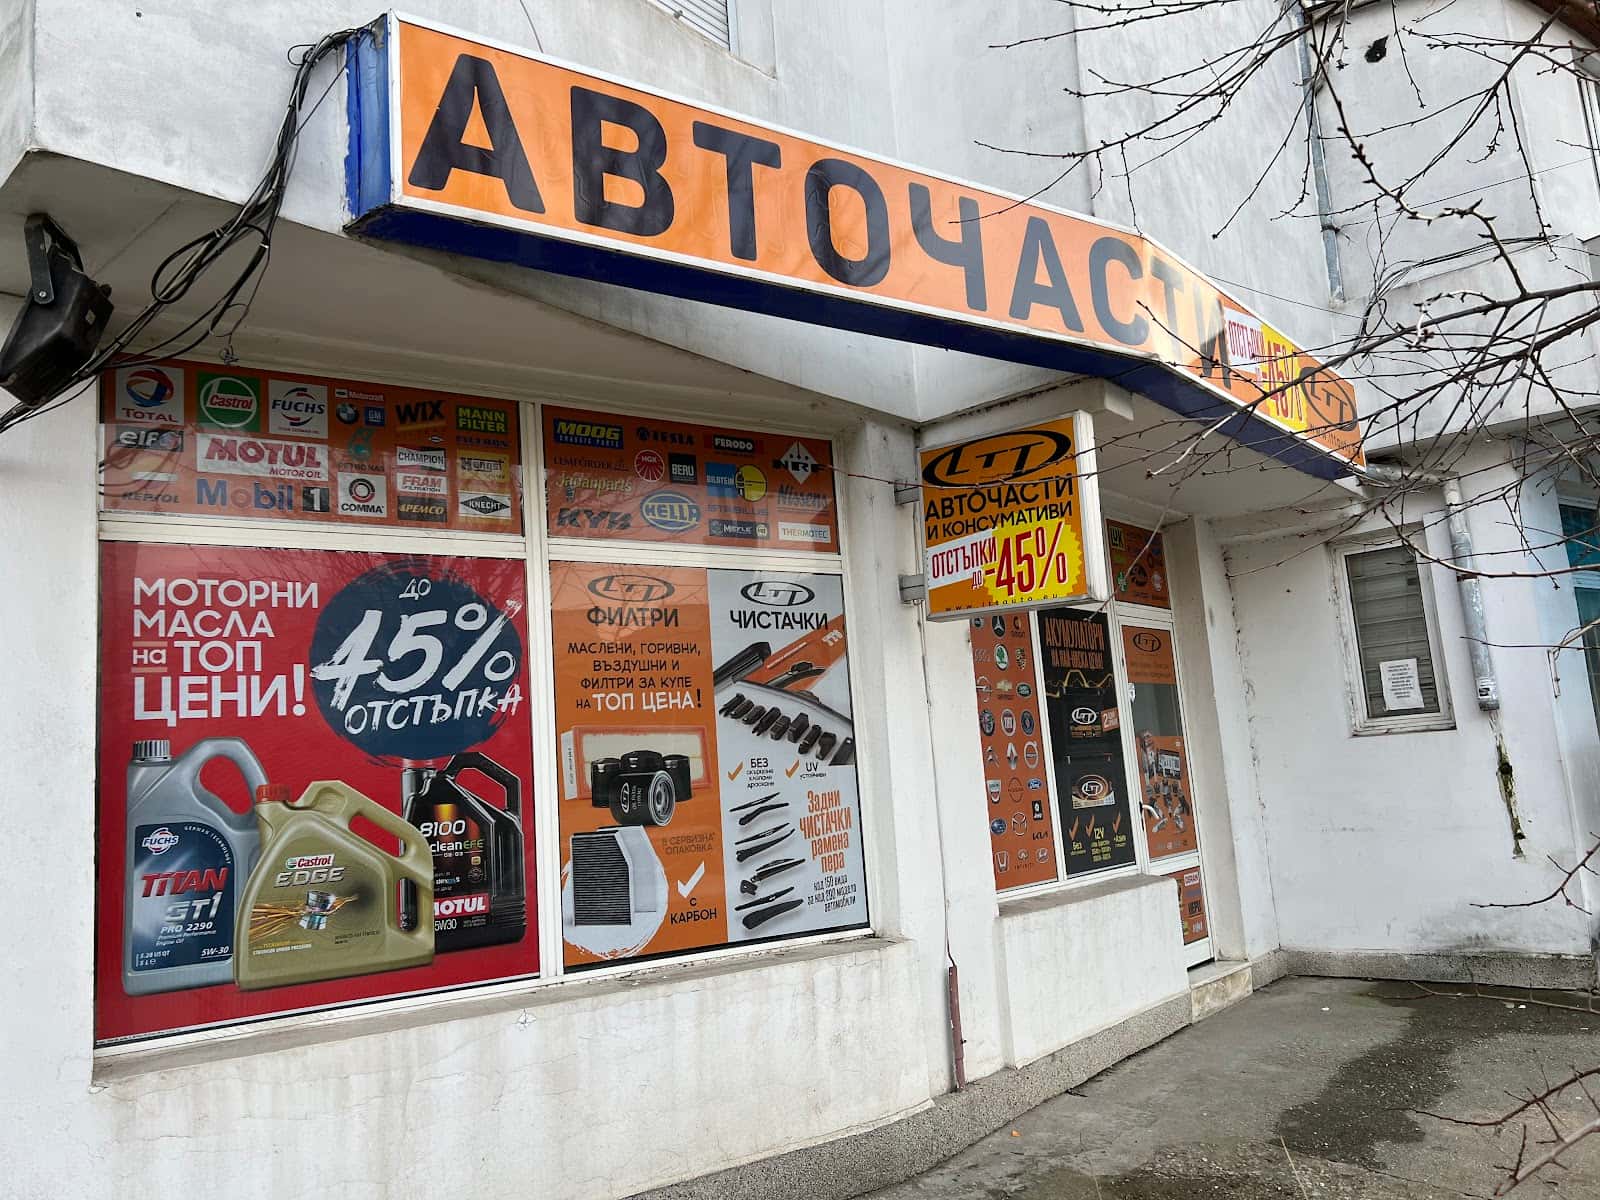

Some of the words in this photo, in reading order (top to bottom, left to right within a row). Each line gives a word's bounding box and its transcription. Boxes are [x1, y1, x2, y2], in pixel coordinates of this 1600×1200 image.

[409, 53, 1232, 390] АВТОЧАСТИ
[209, 394, 253, 410] Castrol
[271, 399, 326, 415] FUCHS
[395, 400, 445, 423] WIX
[122, 407, 178, 423] TOTAL
[458, 407, 505, 422] MANN
[458, 418, 506, 433] FILTER
[557, 421, 620, 441] MOOG
[119, 430, 160, 447] elf
[714, 438, 753, 450] FERODO
[205, 437, 321, 469] MOTUL
[398, 450, 444, 465] CHAMPION
[269, 467, 304, 478] MOTOR
[305, 469, 321, 479] OIL
[672, 463, 695, 477] BERU
[772, 458, 825, 473] NRF
[402, 475, 442, 488] FRAM
[556, 472, 632, 496] Japanparts
[196, 478, 294, 510] Mobil
[310, 487, 321, 511] 1
[925, 474, 1074, 522] АВТОЧАСТИ
[469, 501, 501, 511] KNECHT
[644, 502, 700, 522] HELLA
[557, 507, 632, 530] KYB
[927, 523, 938, 541] И
[943, 500, 1073, 538] КОНСУМАТИВИ
[783, 527, 828, 539] THERMOTEC
[931, 536, 997, 579] ОТСТЪПКИ
[985, 521, 1067, 597] -45%
[132, 577, 319, 609] МОТОРНИ
[132, 608, 275, 639] МАСЛА
[586, 605, 680, 628] ФИЛТРИ
[730, 610, 829, 631] ЧИСТАЧКИ
[1045, 617, 1105, 651] АКУМУЛАТОРИ
[132, 648, 167, 666] на
[173, 639, 262, 673] ТОП
[311, 599, 522, 712] 45%
[567, 641, 636, 657] МАСЛЕНИ,
[639, 641, 701, 657] ГОРИВНИ,
[593, 658, 668, 674] ВЪЗДУШНИ
[671, 658, 680, 671] И
[580, 675, 634, 689] ФИЛТРИ
[638, 676, 656, 689] ЗА
[660, 675, 692, 689] КУПЕ
[133, 663, 306, 728] ЦЕНИ!
[576, 699, 591, 710] НА
[592, 691, 634, 712] ТОП
[642, 688, 702, 713] ЦЕНА!
[344, 683, 524, 735] ОТСТЪПКА
[750, 757, 769, 768] БЕЗ
[805, 761, 819, 772] UV
[807, 790, 841, 814] Задни
[420, 819, 466, 838] 8100
[799, 806, 852, 840] ЧИСТАЧКИ
[143, 835, 179, 847] FUCHS
[665, 843, 713, 856] ОПАКОВКА
[811, 831, 850, 862] рамена
[298, 855, 331, 868] Castrol
[821, 851, 845, 874] пера
[274, 867, 345, 888] EDGE
[689, 897, 698, 908] С
[670, 908, 718, 926] КАРБОН
[161, 926, 183, 935] PRO
[186, 921, 213, 932] 2290
[201, 945, 230, 958] 5W-30
